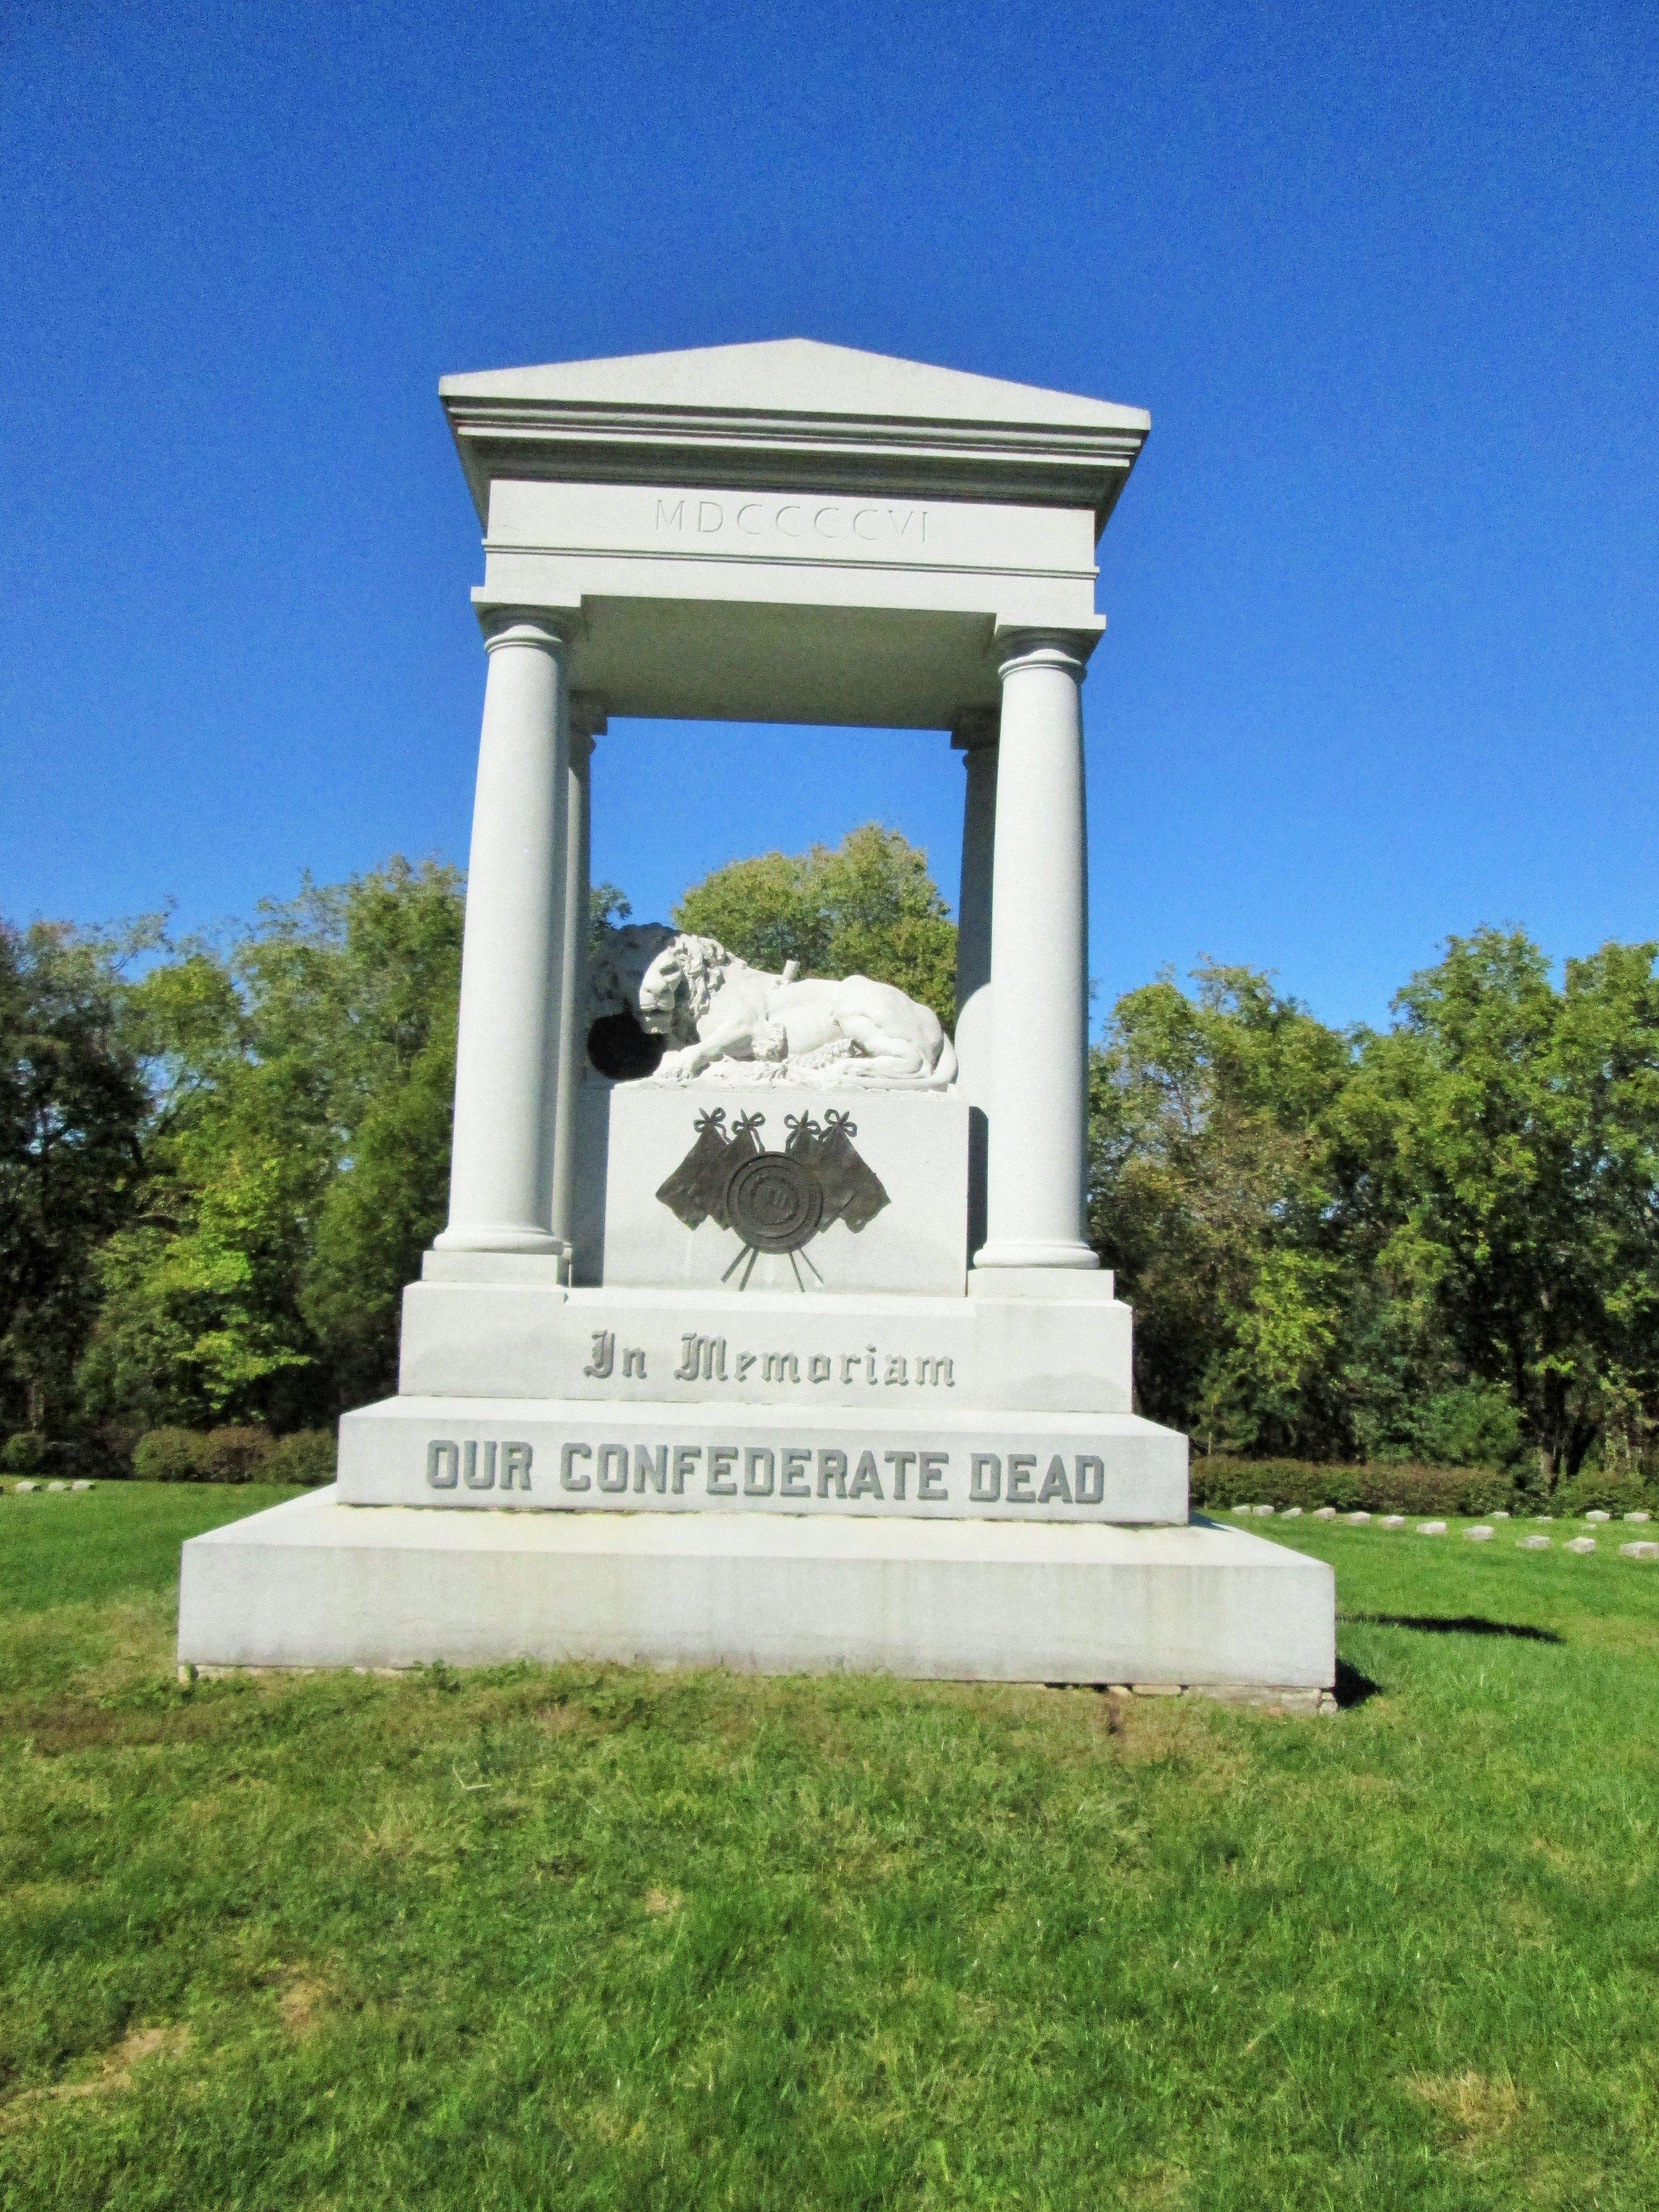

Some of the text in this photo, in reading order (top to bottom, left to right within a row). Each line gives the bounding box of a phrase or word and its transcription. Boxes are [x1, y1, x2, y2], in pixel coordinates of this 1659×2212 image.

[655, 500, 928, 542] MDCCCCVI
[584, 1329, 955, 1386] In Memoriam
[427, 1440, 1104, 1503] OUR CONFEDERATE DEAD
